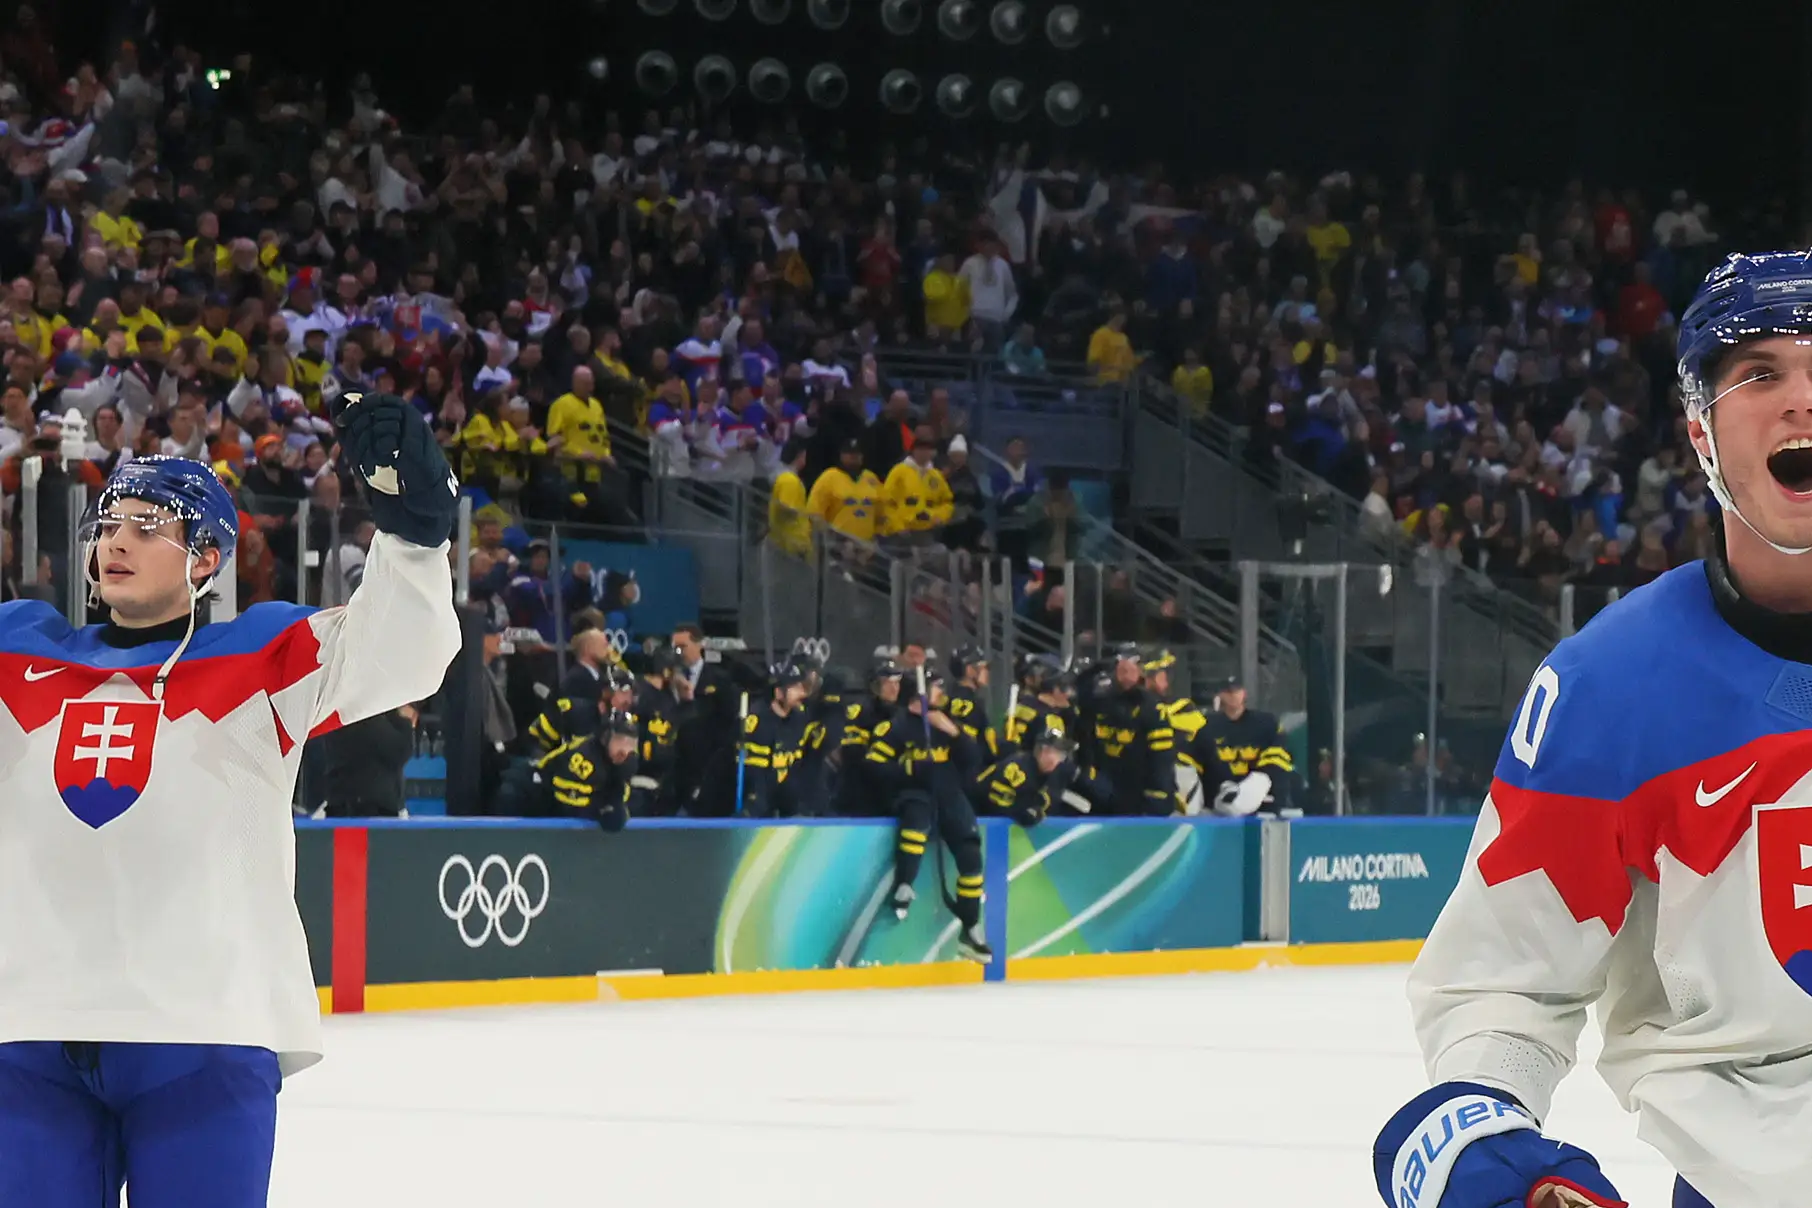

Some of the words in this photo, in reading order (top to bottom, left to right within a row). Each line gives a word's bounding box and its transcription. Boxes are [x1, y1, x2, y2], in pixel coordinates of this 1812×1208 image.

[1510, 658, 1559, 769] 0
[1298, 855, 1364, 882] MILANO
[1365, 852, 1429, 880] CORTINA
[1348, 883, 1381, 911] 2026
